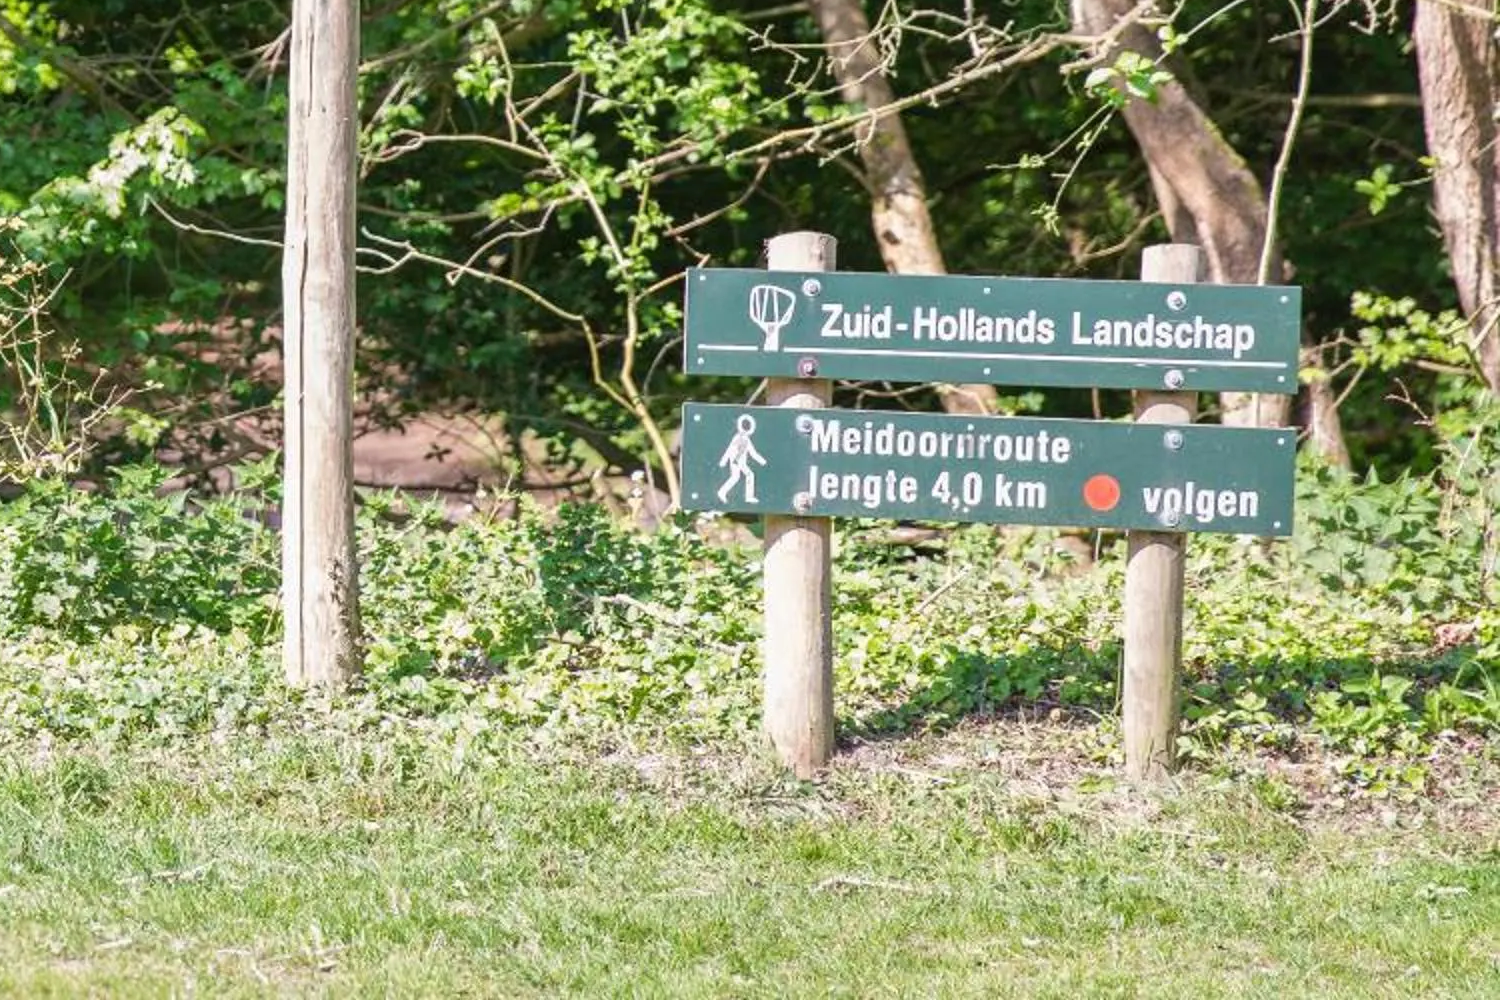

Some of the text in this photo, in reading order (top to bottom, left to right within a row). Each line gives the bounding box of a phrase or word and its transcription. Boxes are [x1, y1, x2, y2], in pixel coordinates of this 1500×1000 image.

[821, 304, 1255, 358] Zuid-Hollands Landschap
[809, 465, 1259, 528] lengte 4,0 km volgen
